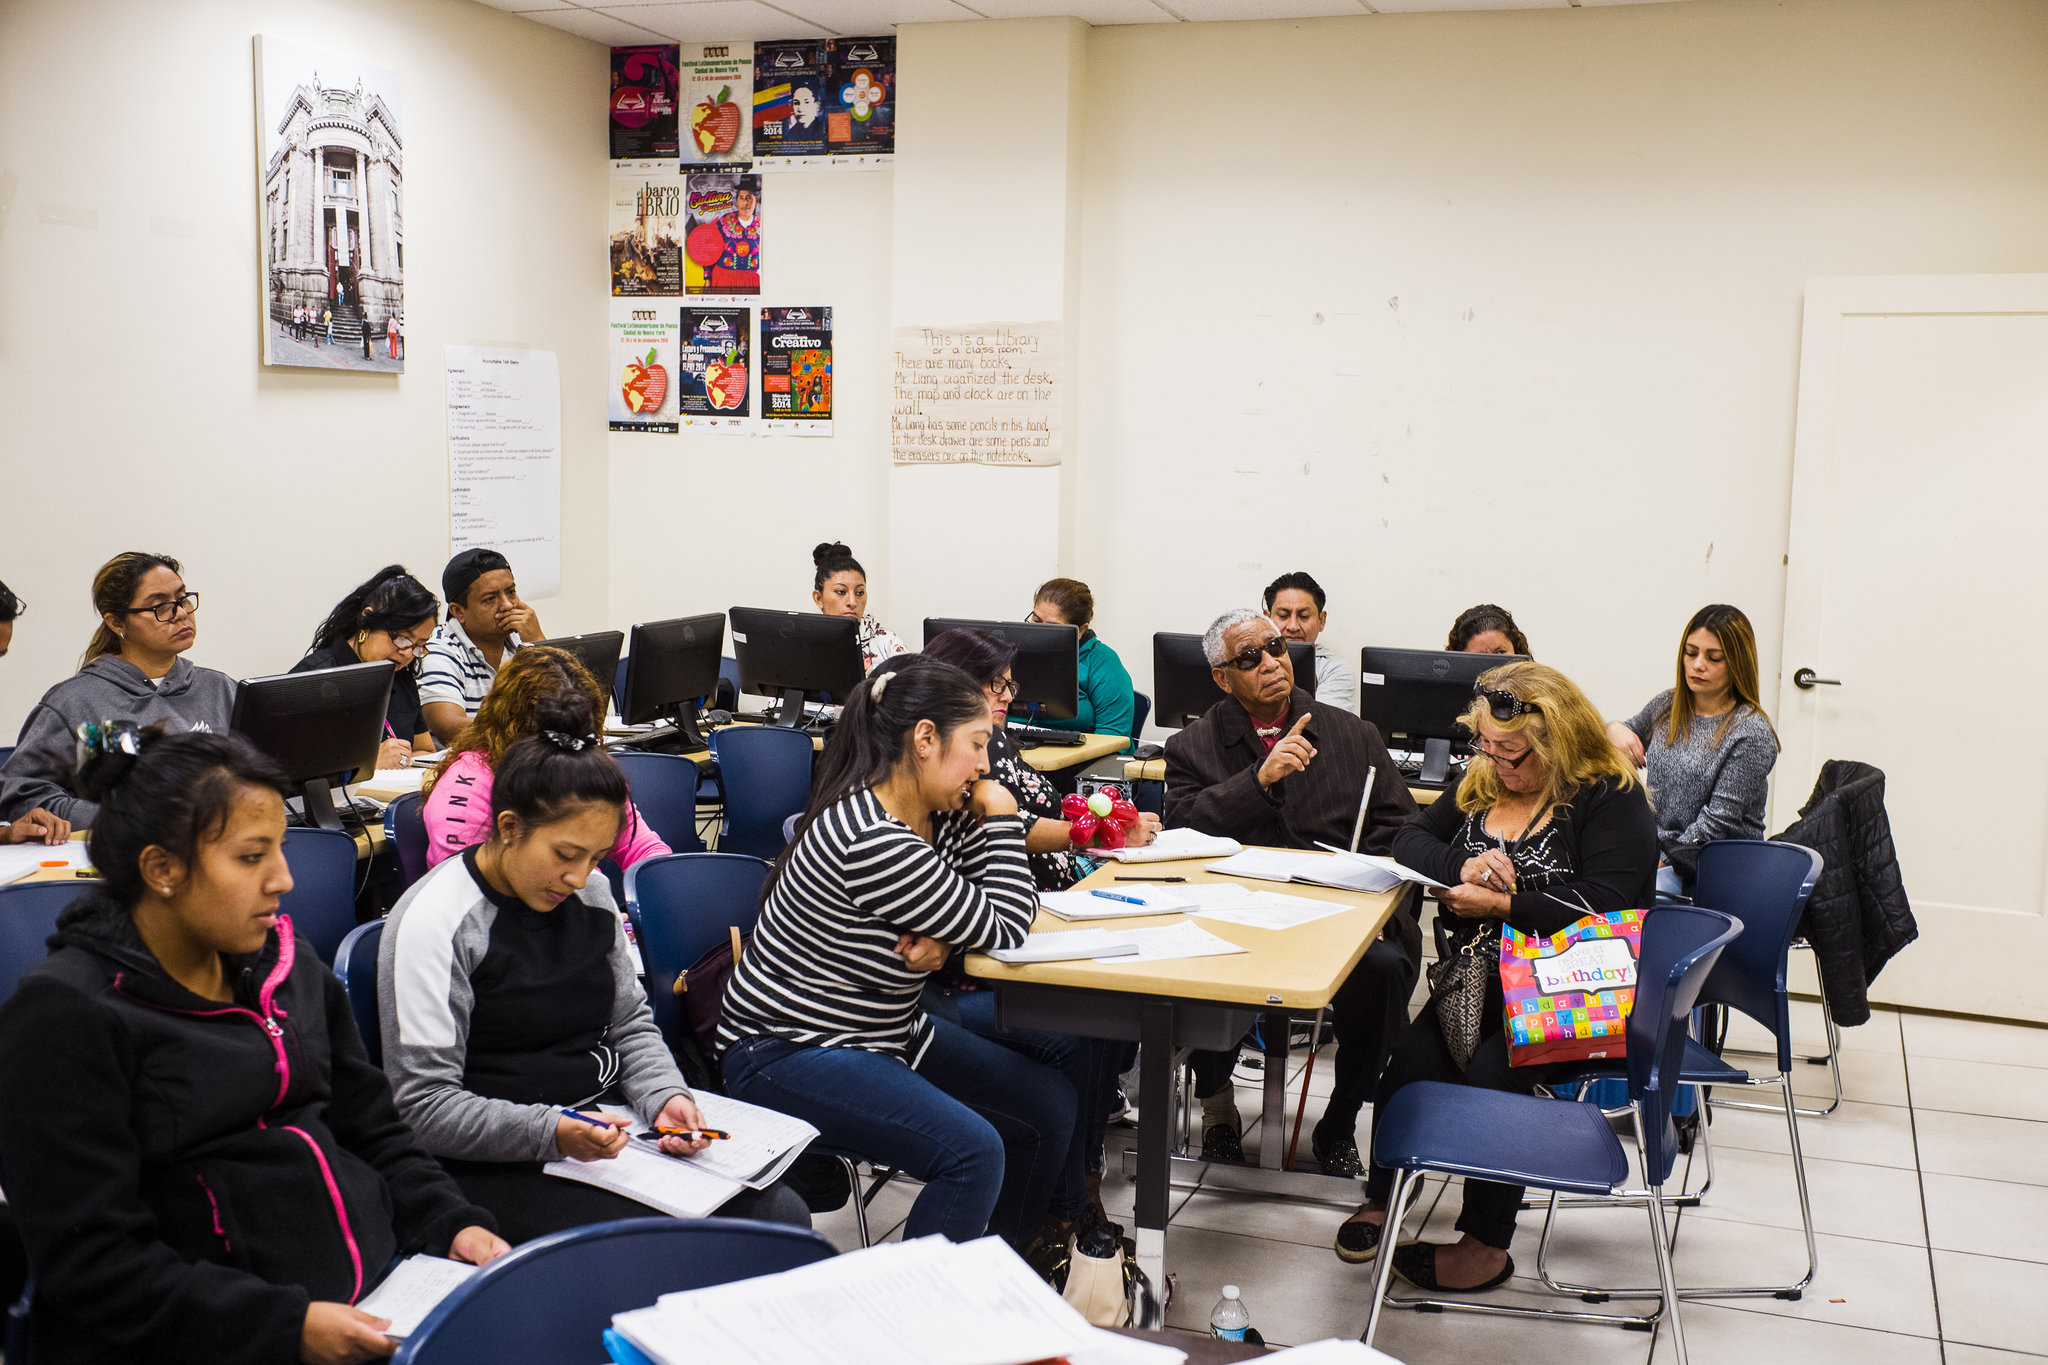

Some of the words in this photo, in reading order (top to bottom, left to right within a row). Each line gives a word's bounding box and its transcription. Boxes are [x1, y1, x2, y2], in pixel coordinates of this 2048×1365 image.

[646, 182, 679, 197] barco
[636, 196, 680, 216] EBRIO
[689, 191, 732, 209] Cultura
[772, 336, 821, 348] Creativo
[921, 329, 951, 347] This
[960, 334, 971, 346] is
[976, 336, 985, 346] a
[996, 329, 1039, 352] Library
[895, 352, 922, 369] There
[925, 359, 943, 369] are
[948, 359, 974, 374] many
[980, 354, 1012, 370] books.
[913, 372, 938, 390] Liang
[944, 371, 996, 390] organized
[1002, 371, 1019, 384] the
[1024, 368, 1053, 385] desk.
[893, 387, 912, 400] The
[918, 390, 940, 404] map
[943, 386, 960, 400] and
[964, 387, 993, 400] clock
[997, 390, 1014, 400] are
[1017, 389, 1028, 400] on
[1034, 387, 1052, 400] the
[894, 400, 922, 415] wall.
[928, 416, 943, 431] has
[946, 420, 967, 431] some
[970, 417, 998, 433] pencils
[1000, 420, 1008, 430] in
[1011, 418, 1022, 431] his
[1026, 416, 1048, 431] hand.
[892, 431, 900, 446] In
[904, 433, 915, 446] the
[918, 432, 937, 446] desk
[939, 432, 966, 447] drawer
[969, 437, 982, 447] are
[986, 438, 1007, 447] some
[1011, 437, 1030, 452] pens
[1033, 432, 1050, 447] and
[893, 448, 906, 461] the
[908, 452, 940, 462] erasers
[943, 452, 957, 462] are
[971, 450, 983, 462] the
[986, 449, 1032, 462] notebooks.
[446, 774, 476, 845] PINK
[1557, 948, 1590, 965] have
[1560, 954, 1604, 972] GREAT
[1546, 965, 1632, 986] birthday!
